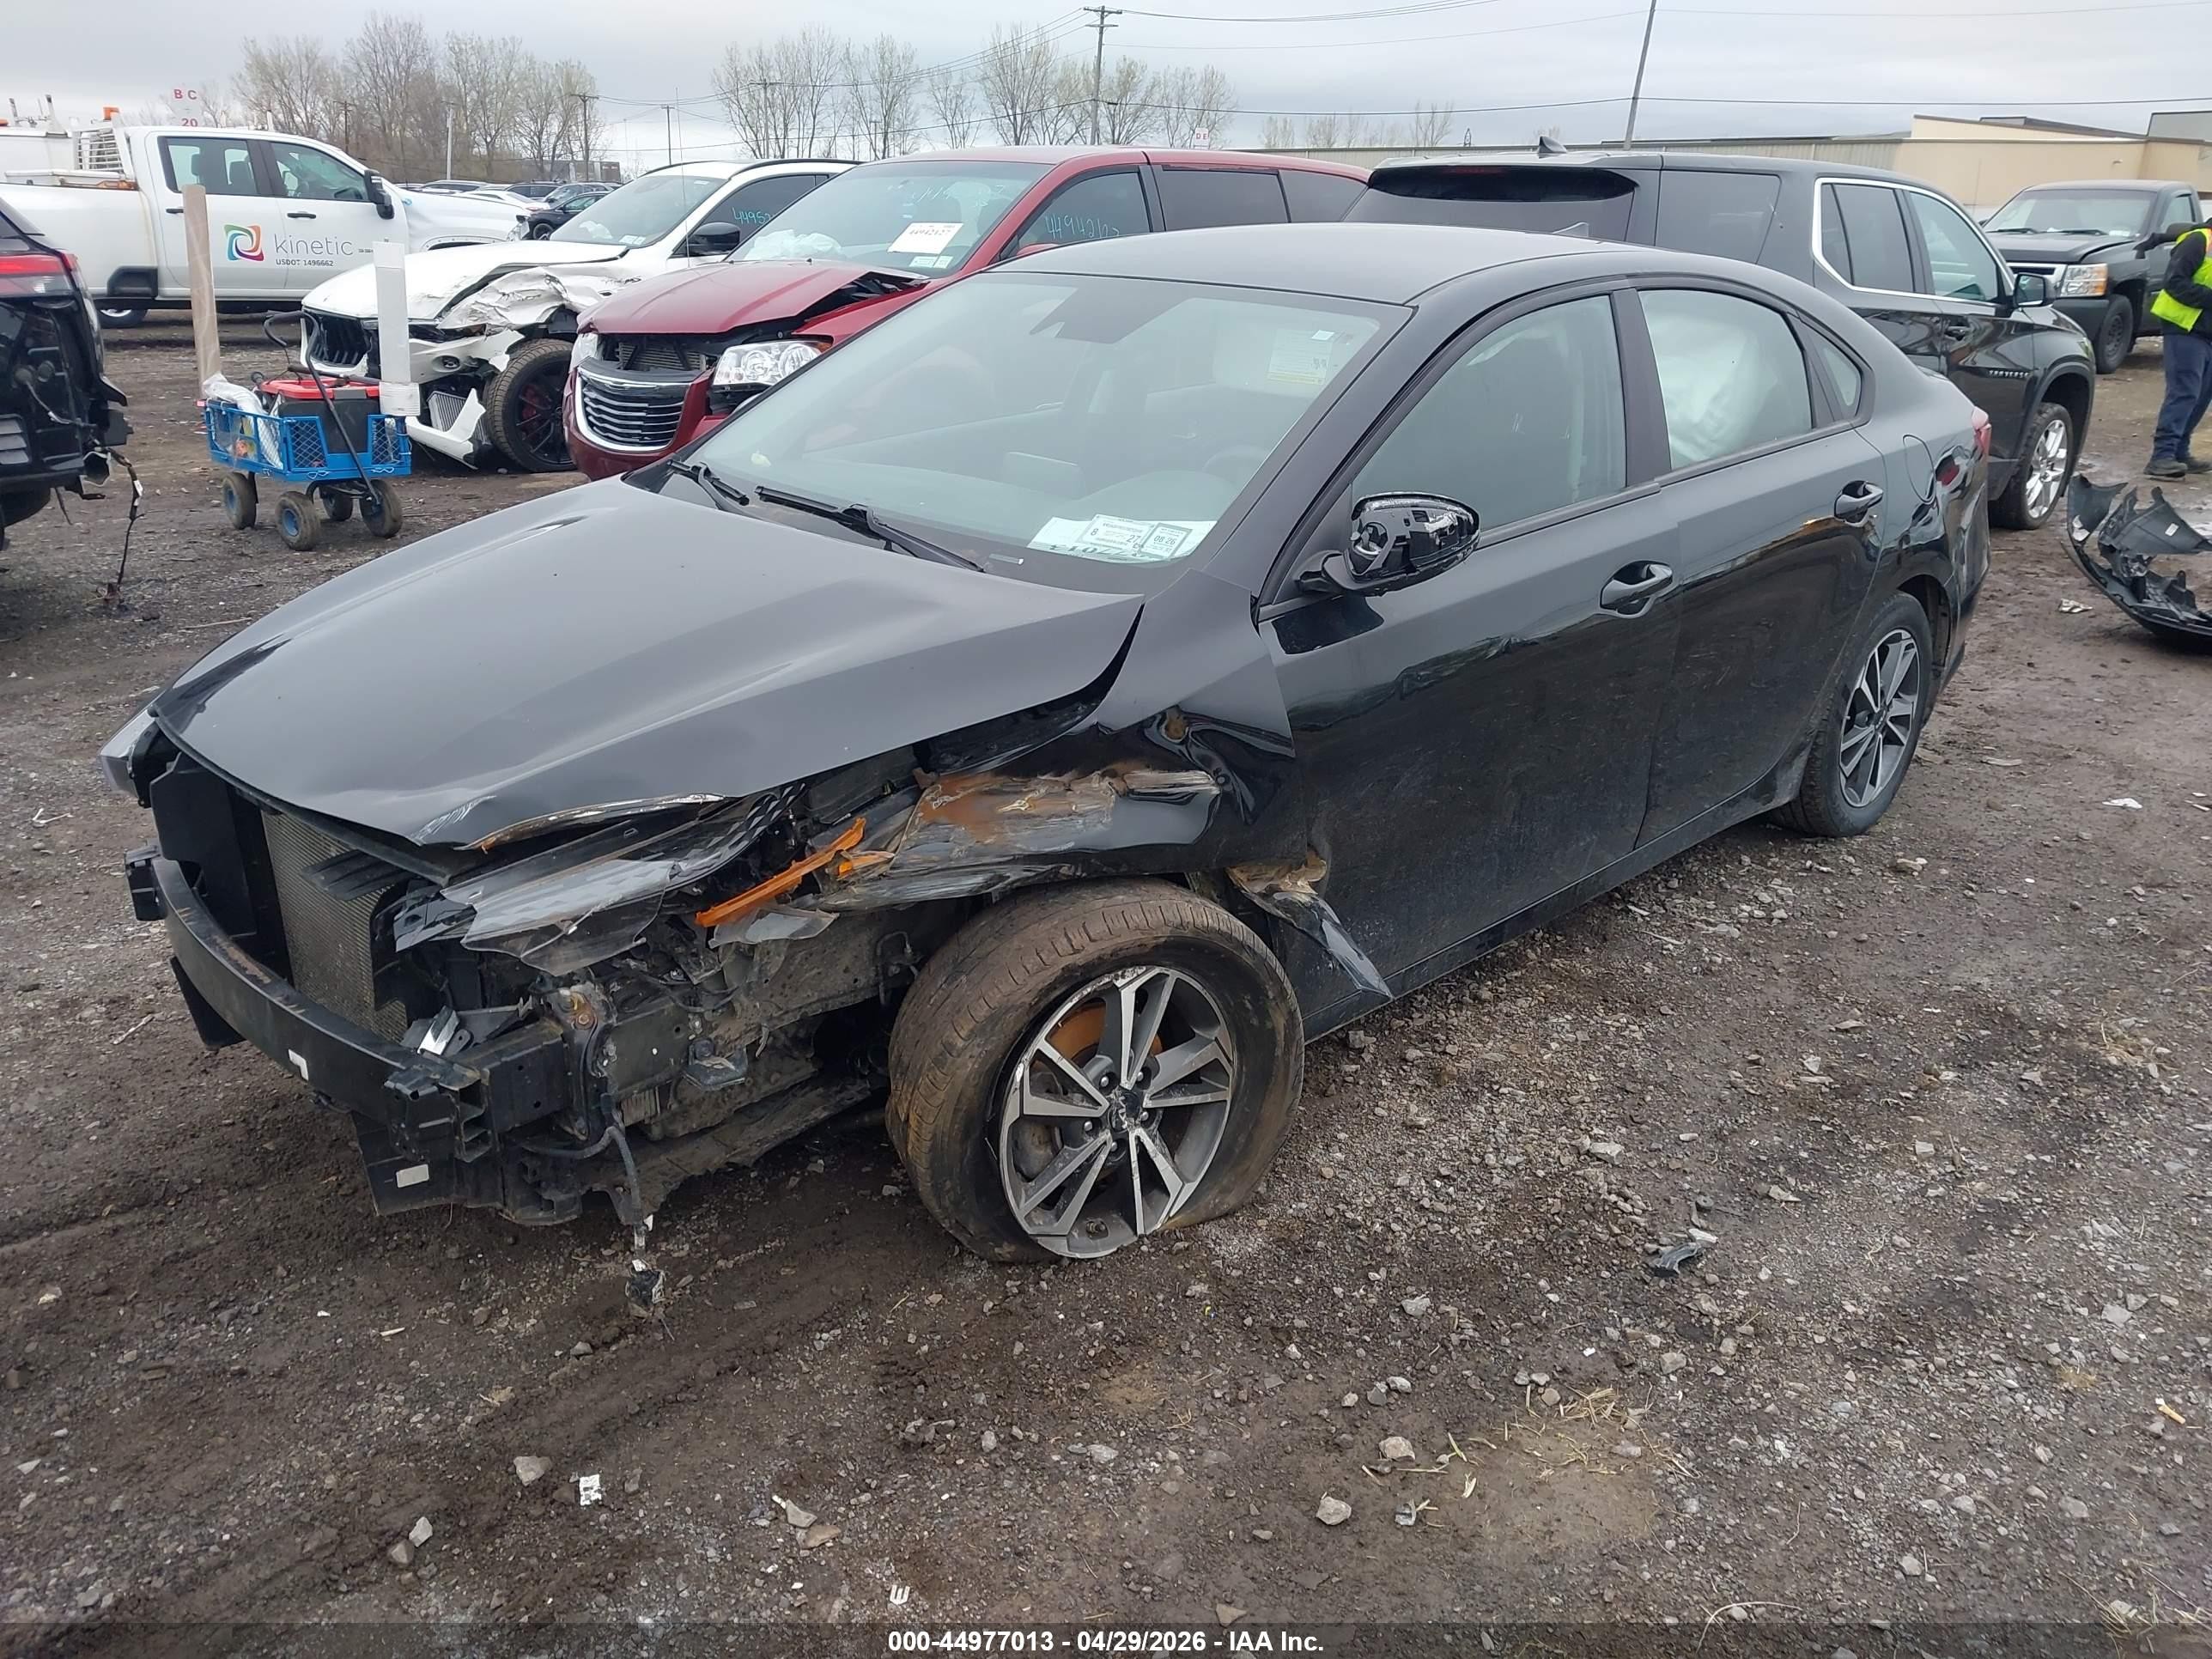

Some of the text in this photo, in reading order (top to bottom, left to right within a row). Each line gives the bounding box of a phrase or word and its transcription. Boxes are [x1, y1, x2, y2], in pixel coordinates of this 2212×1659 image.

[173, 89, 197, 100] B C
[181, 118, 198, 127] 20
[274, 234, 353, 255] kinetic
[1126, 534, 1142, 544] 27
